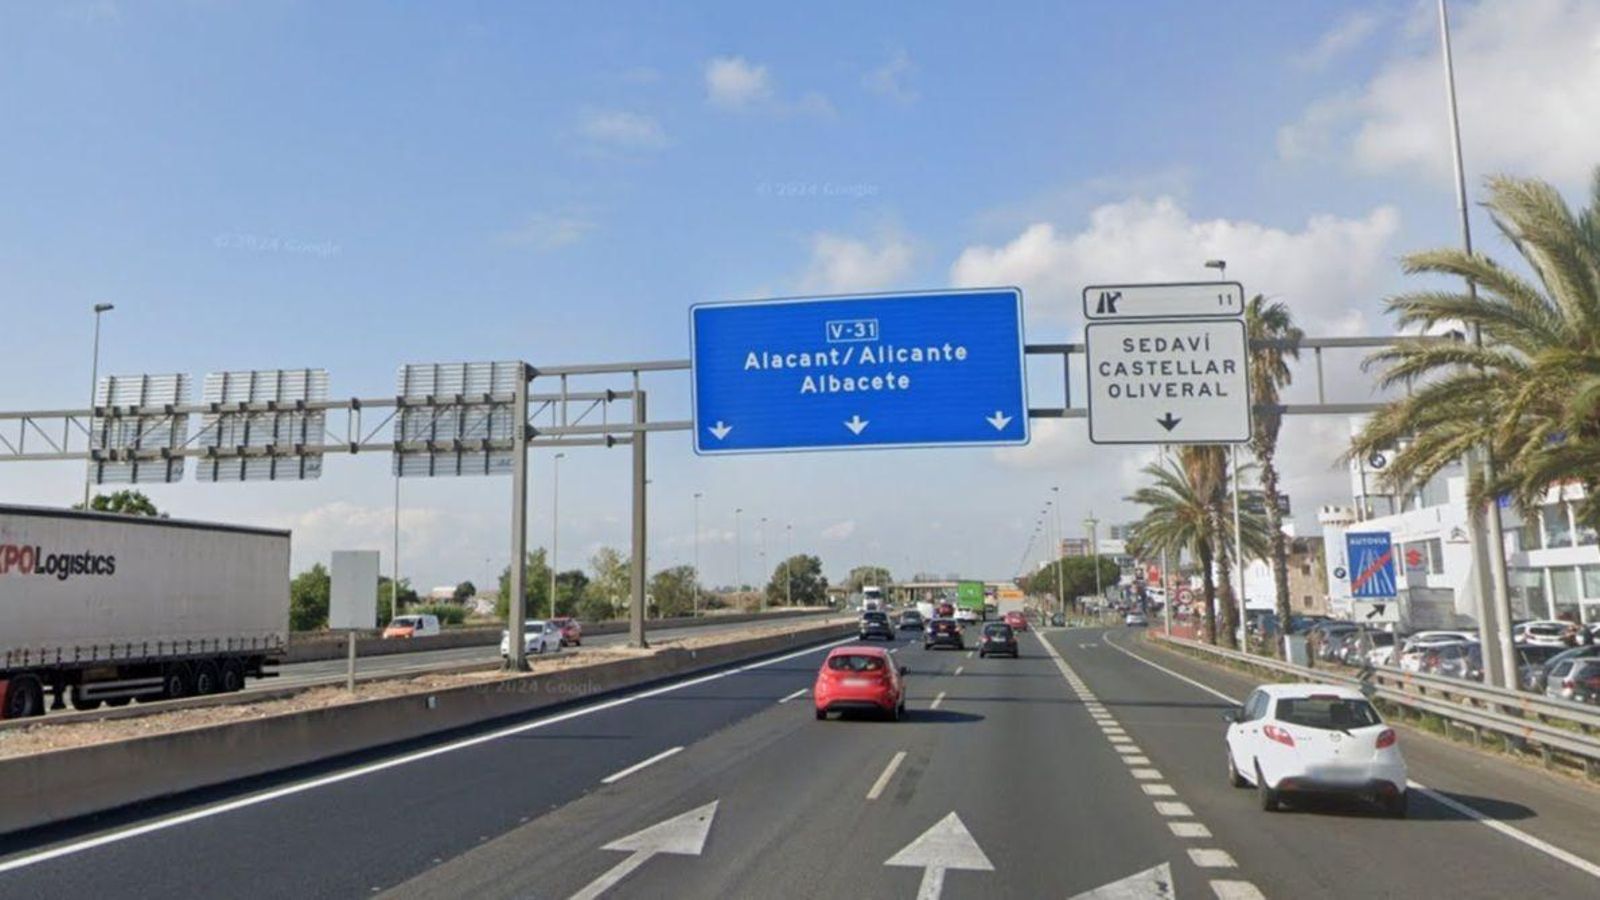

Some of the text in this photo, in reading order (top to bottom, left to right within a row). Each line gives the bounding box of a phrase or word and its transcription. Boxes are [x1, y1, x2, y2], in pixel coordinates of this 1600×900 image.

[1218, 294, 1233, 306] 11
[831, 322, 877, 339] V-31
[1122, 333, 1210, 353] SEDAVÍ
[744, 343, 968, 370] Alacant/Alicante
[1099, 359, 1236, 377] CASTELLAR
[800, 372, 911, 394] Albacete
[1108, 382, 1228, 399] OLIVERAL
